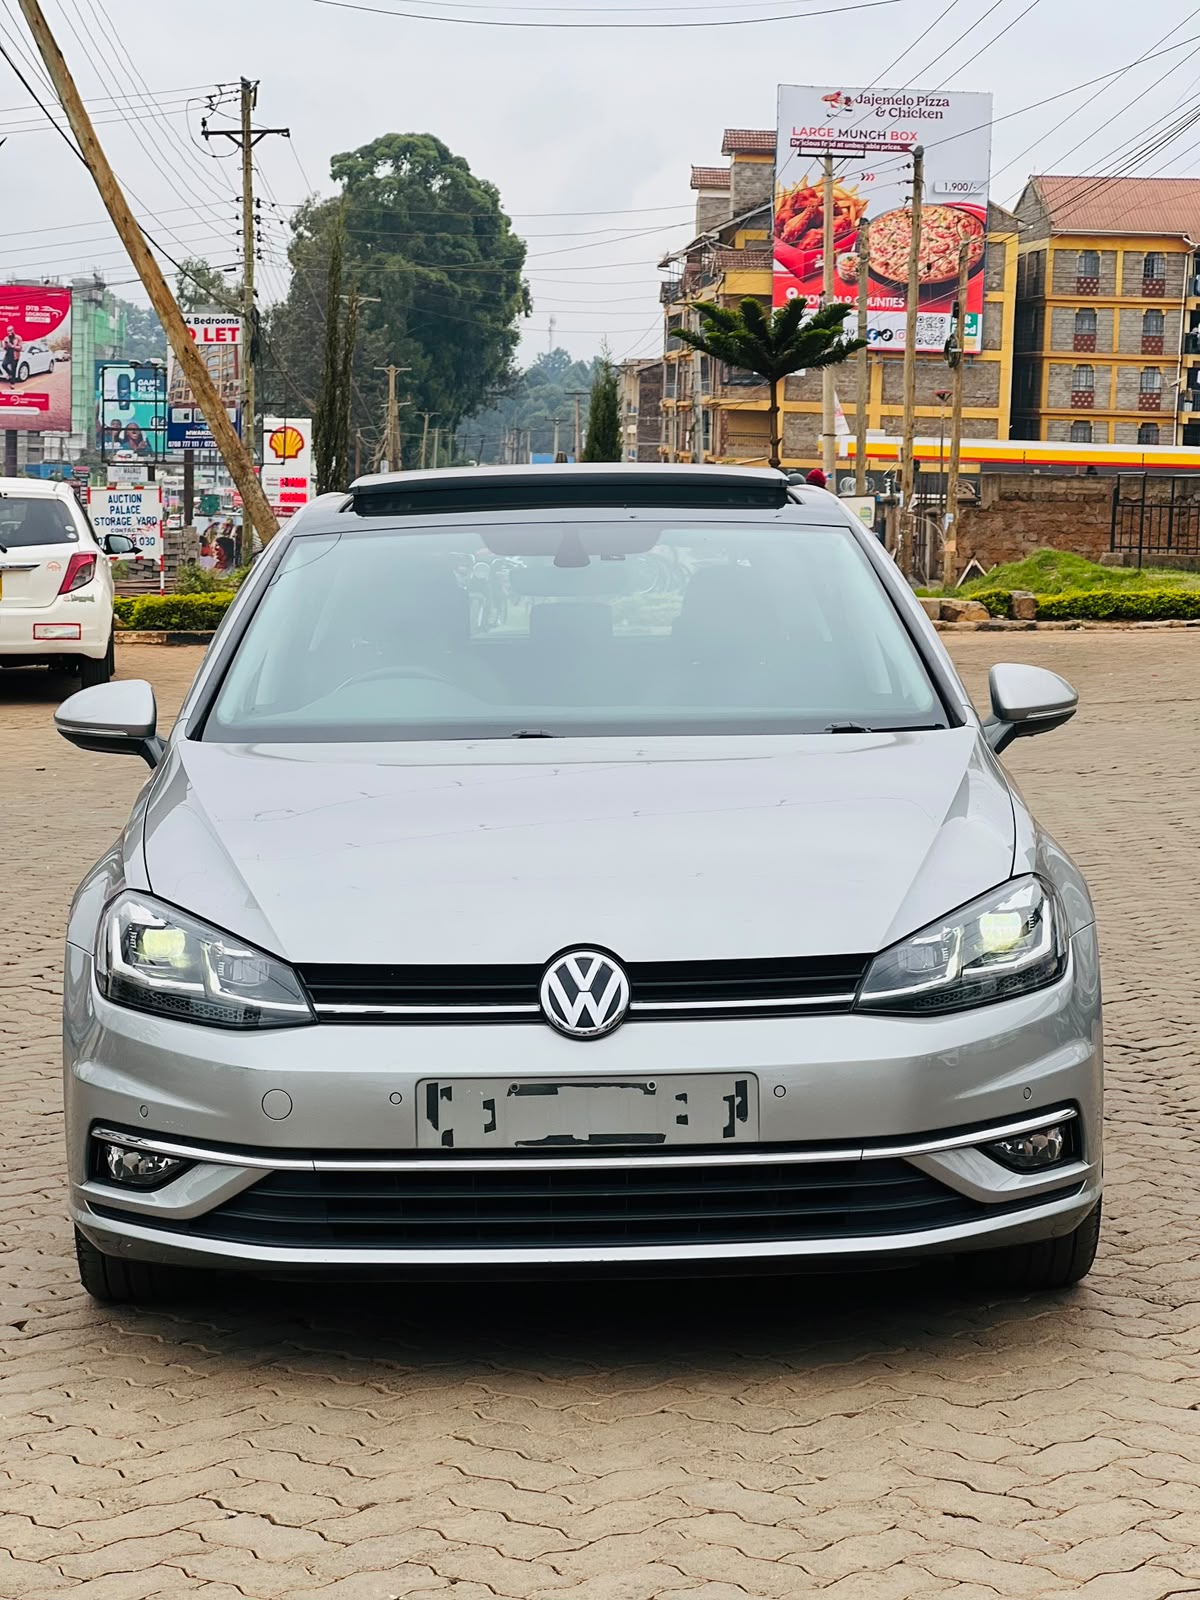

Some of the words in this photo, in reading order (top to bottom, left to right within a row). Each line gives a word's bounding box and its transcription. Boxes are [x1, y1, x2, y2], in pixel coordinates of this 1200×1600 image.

[856, 94, 914, 107] Jajemelo
[917, 95, 950, 107] Pizza
[875, 107, 885, 117] &
[888, 107, 944, 119] Chicken
[792, 127, 834, 138] LARGE
[838, 129, 886, 141] MUNCH
[890, 131, 918, 141] BOX
[944, 182, 977, 192] 1,900/-
[194, 316, 240, 325] Bedrooms
[203, 327, 240, 342] LET
[108, 494, 142, 504] AUCTION
[110, 505, 141, 514] PALACE
[94, 517, 132, 526] STORAGE
[136, 516, 157, 526] YARD
[541, 951, 629, 1032] VW
